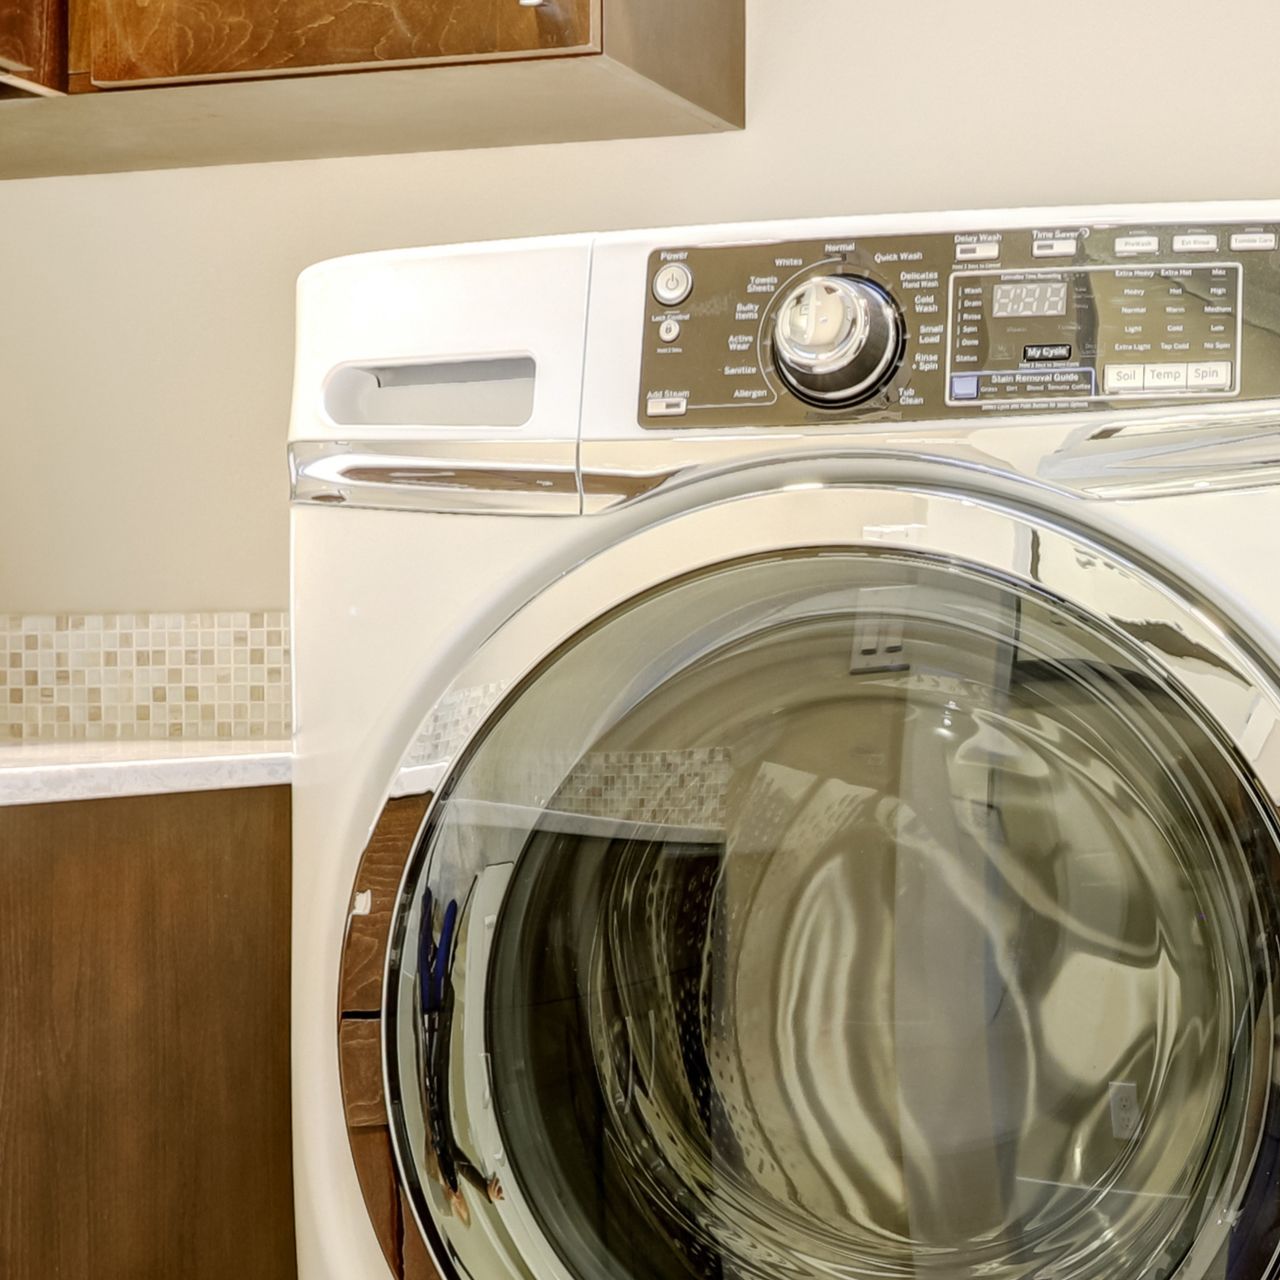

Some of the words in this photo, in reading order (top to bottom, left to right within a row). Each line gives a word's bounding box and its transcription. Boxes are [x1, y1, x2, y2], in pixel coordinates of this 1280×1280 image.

[954, 235, 977, 243] Delay
[979, 233, 1002, 242] Wash
[1033, 231, 1053, 239] Time
[1055, 231, 1079, 239] Saver
[825, 242, 855, 252] Normal
[660, 252, 688, 260] Power
[874, 252, 897, 262] Quick
[899, 251, 922, 260] Wash
[775, 257, 802, 266] Whites
[900, 271, 938, 281] Delicates
[1134, 270, 1155, 278] Heavy
[750, 276, 778, 285] Towels
[902, 280, 920, 289] Hand
[921, 278, 939, 287] Wash
[747, 283, 775, 293] Sheets
[1124, 288, 1145, 296] Heavy
[1210, 287, 1226, 296] High
[914, 295, 934, 305] Cold
[736, 303, 759, 313] Bulky
[915, 303, 938, 312] Wash
[736, 311, 758, 320] Items
[919, 324, 943, 333] Small
[1124, 325, 1142, 334] Light
[1167, 324, 1183, 332] Cold
[728, 334, 753, 343] Active
[919, 334, 940, 343] Load
[729, 341, 751, 350] Wear
[1133, 343, 1151, 351] Light
[1161, 343, 1172, 351] Tap
[1173, 342, 1189, 350] Cold
[1215, 342, 1231, 350] Spin
[1027, 348, 1040, 358] My
[1042, 347, 1067, 357] Cycle
[915, 353, 938, 362] Rinse
[724, 365, 756, 375] Sanitize
[920, 361, 938, 372] Spin
[992, 375, 1014, 383] Stain
[1015, 374, 1052, 383] Removal
[1054, 373, 1078, 381] Guide
[1115, 371, 1136, 382] Soil
[1150, 370, 1181, 383] Temp
[1194, 368, 1219, 382] Spin
[647, 390, 663, 399] Add
[664, 389, 690, 398] Steam
[733, 388, 767, 399] Allergen
[898, 387, 915, 396] Tub
[899, 395, 924, 405] Clean
